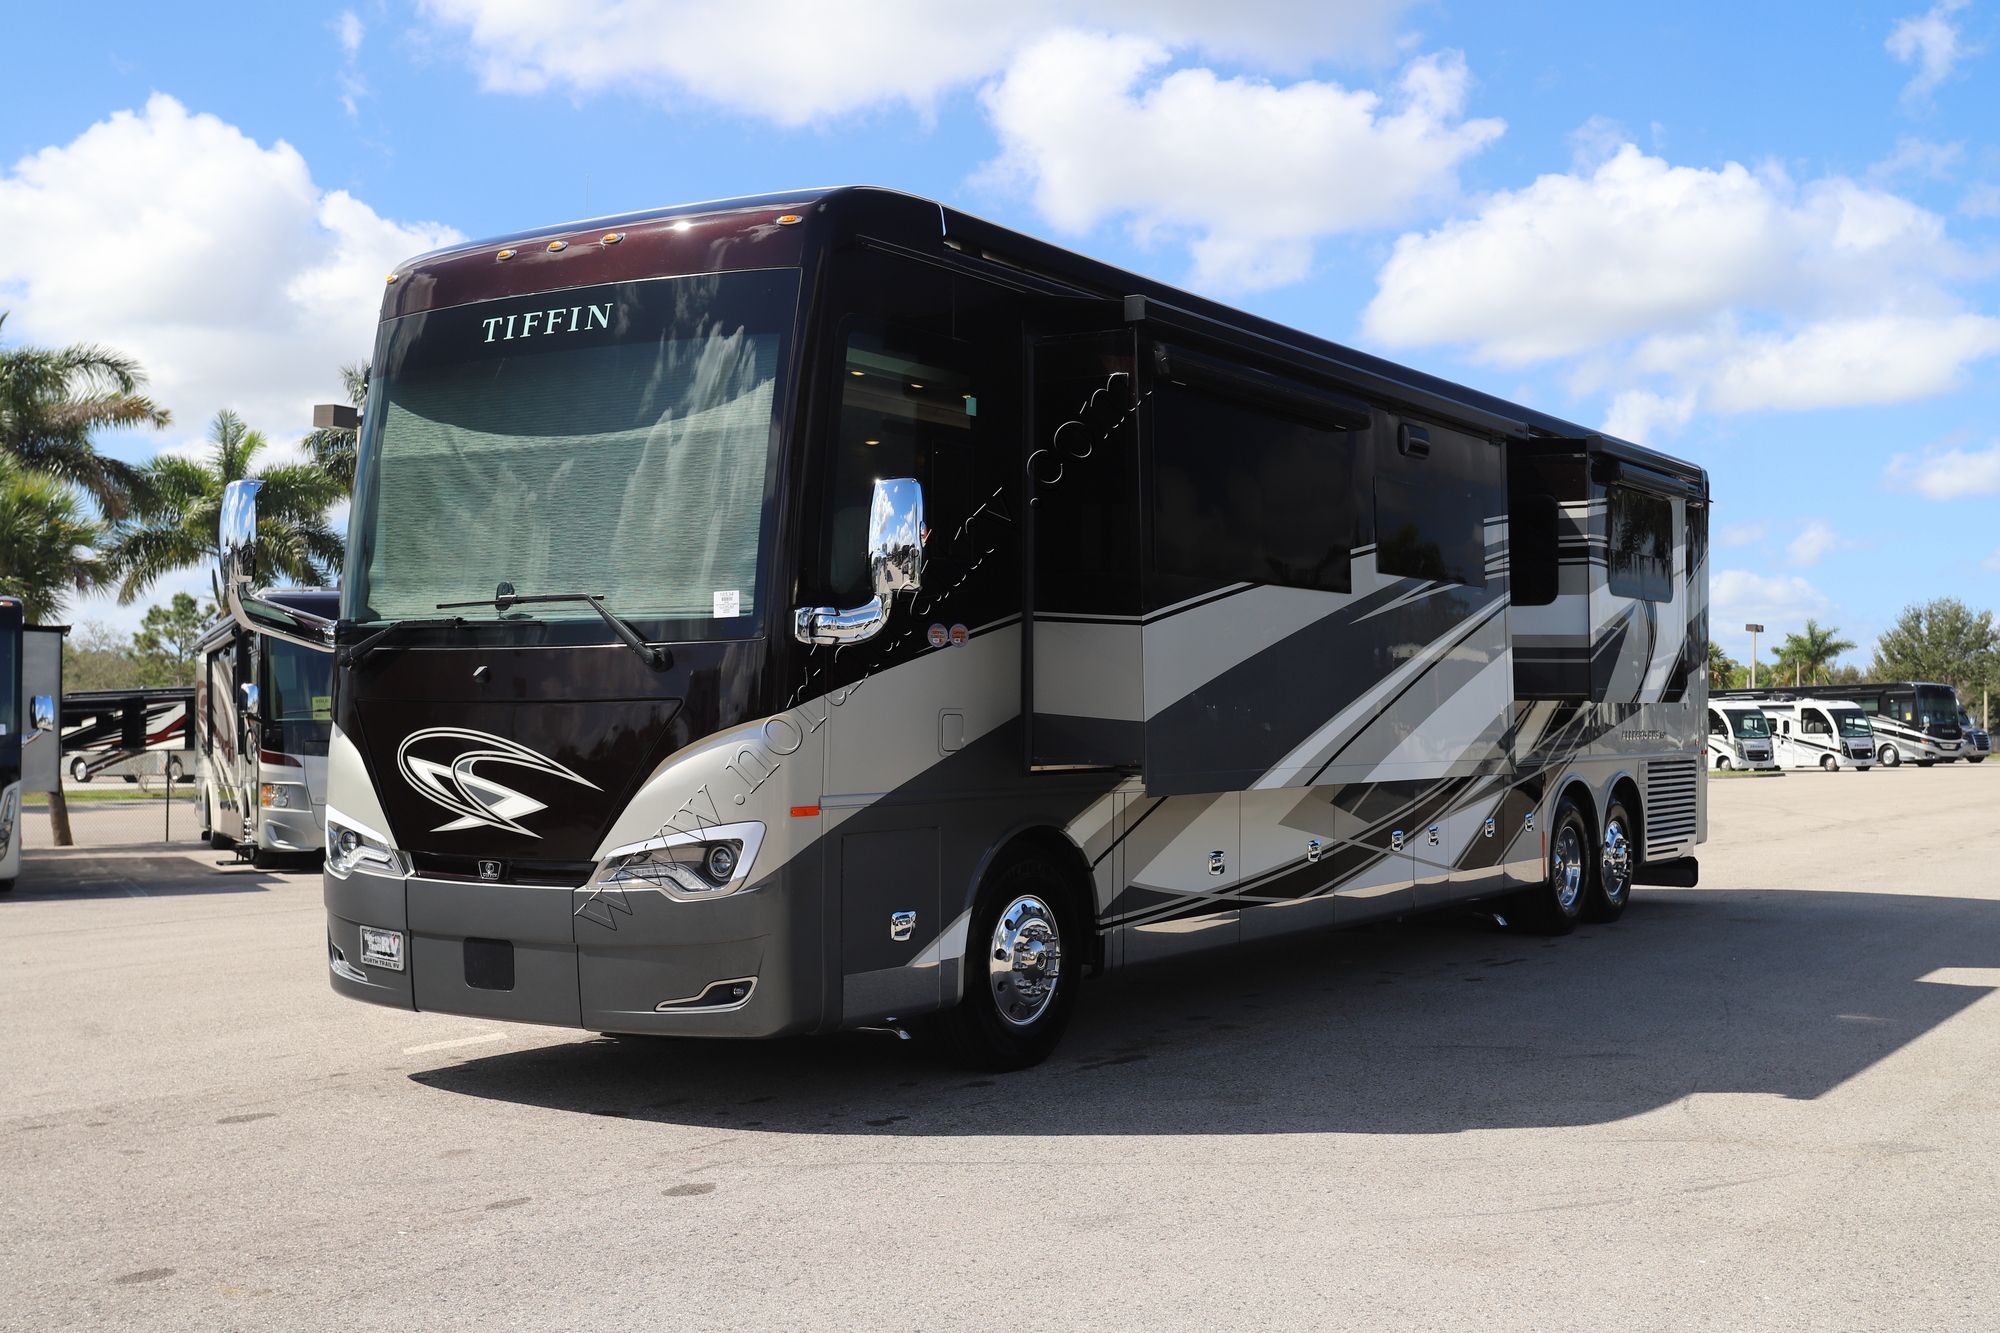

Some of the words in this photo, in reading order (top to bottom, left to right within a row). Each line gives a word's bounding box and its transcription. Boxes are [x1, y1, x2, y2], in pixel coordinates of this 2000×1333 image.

[482, 303, 613, 343] TIFFIN
[363, 957, 379, 965] NORTH
[379, 959, 393, 968] TRAIL
